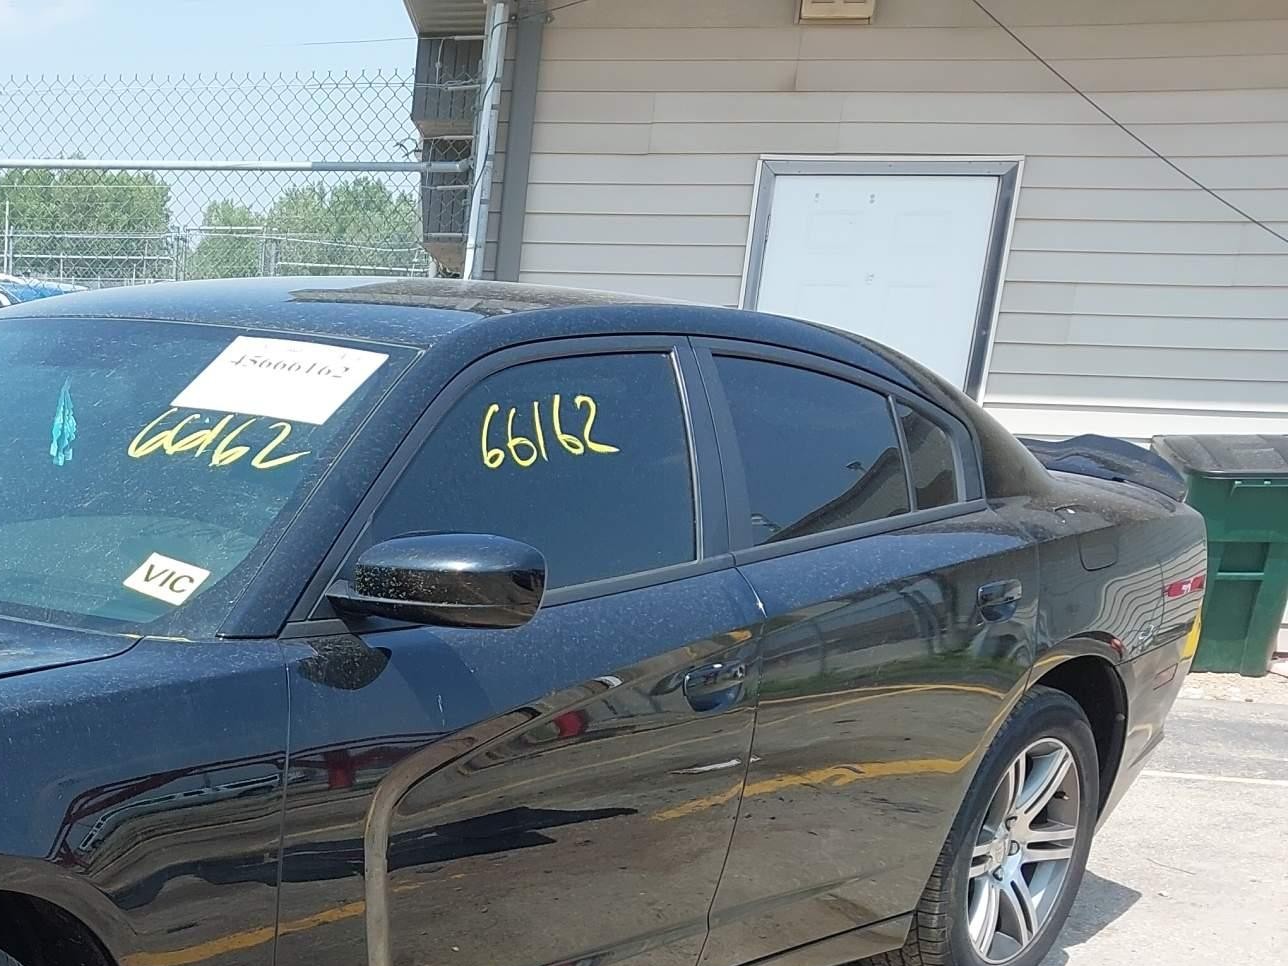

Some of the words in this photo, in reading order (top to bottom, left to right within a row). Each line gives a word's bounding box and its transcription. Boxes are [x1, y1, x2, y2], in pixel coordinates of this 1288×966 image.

[128, 407, 312, 469] 66162
[481, 393, 621, 469] 66162
[144, 564, 195, 593] VIC
